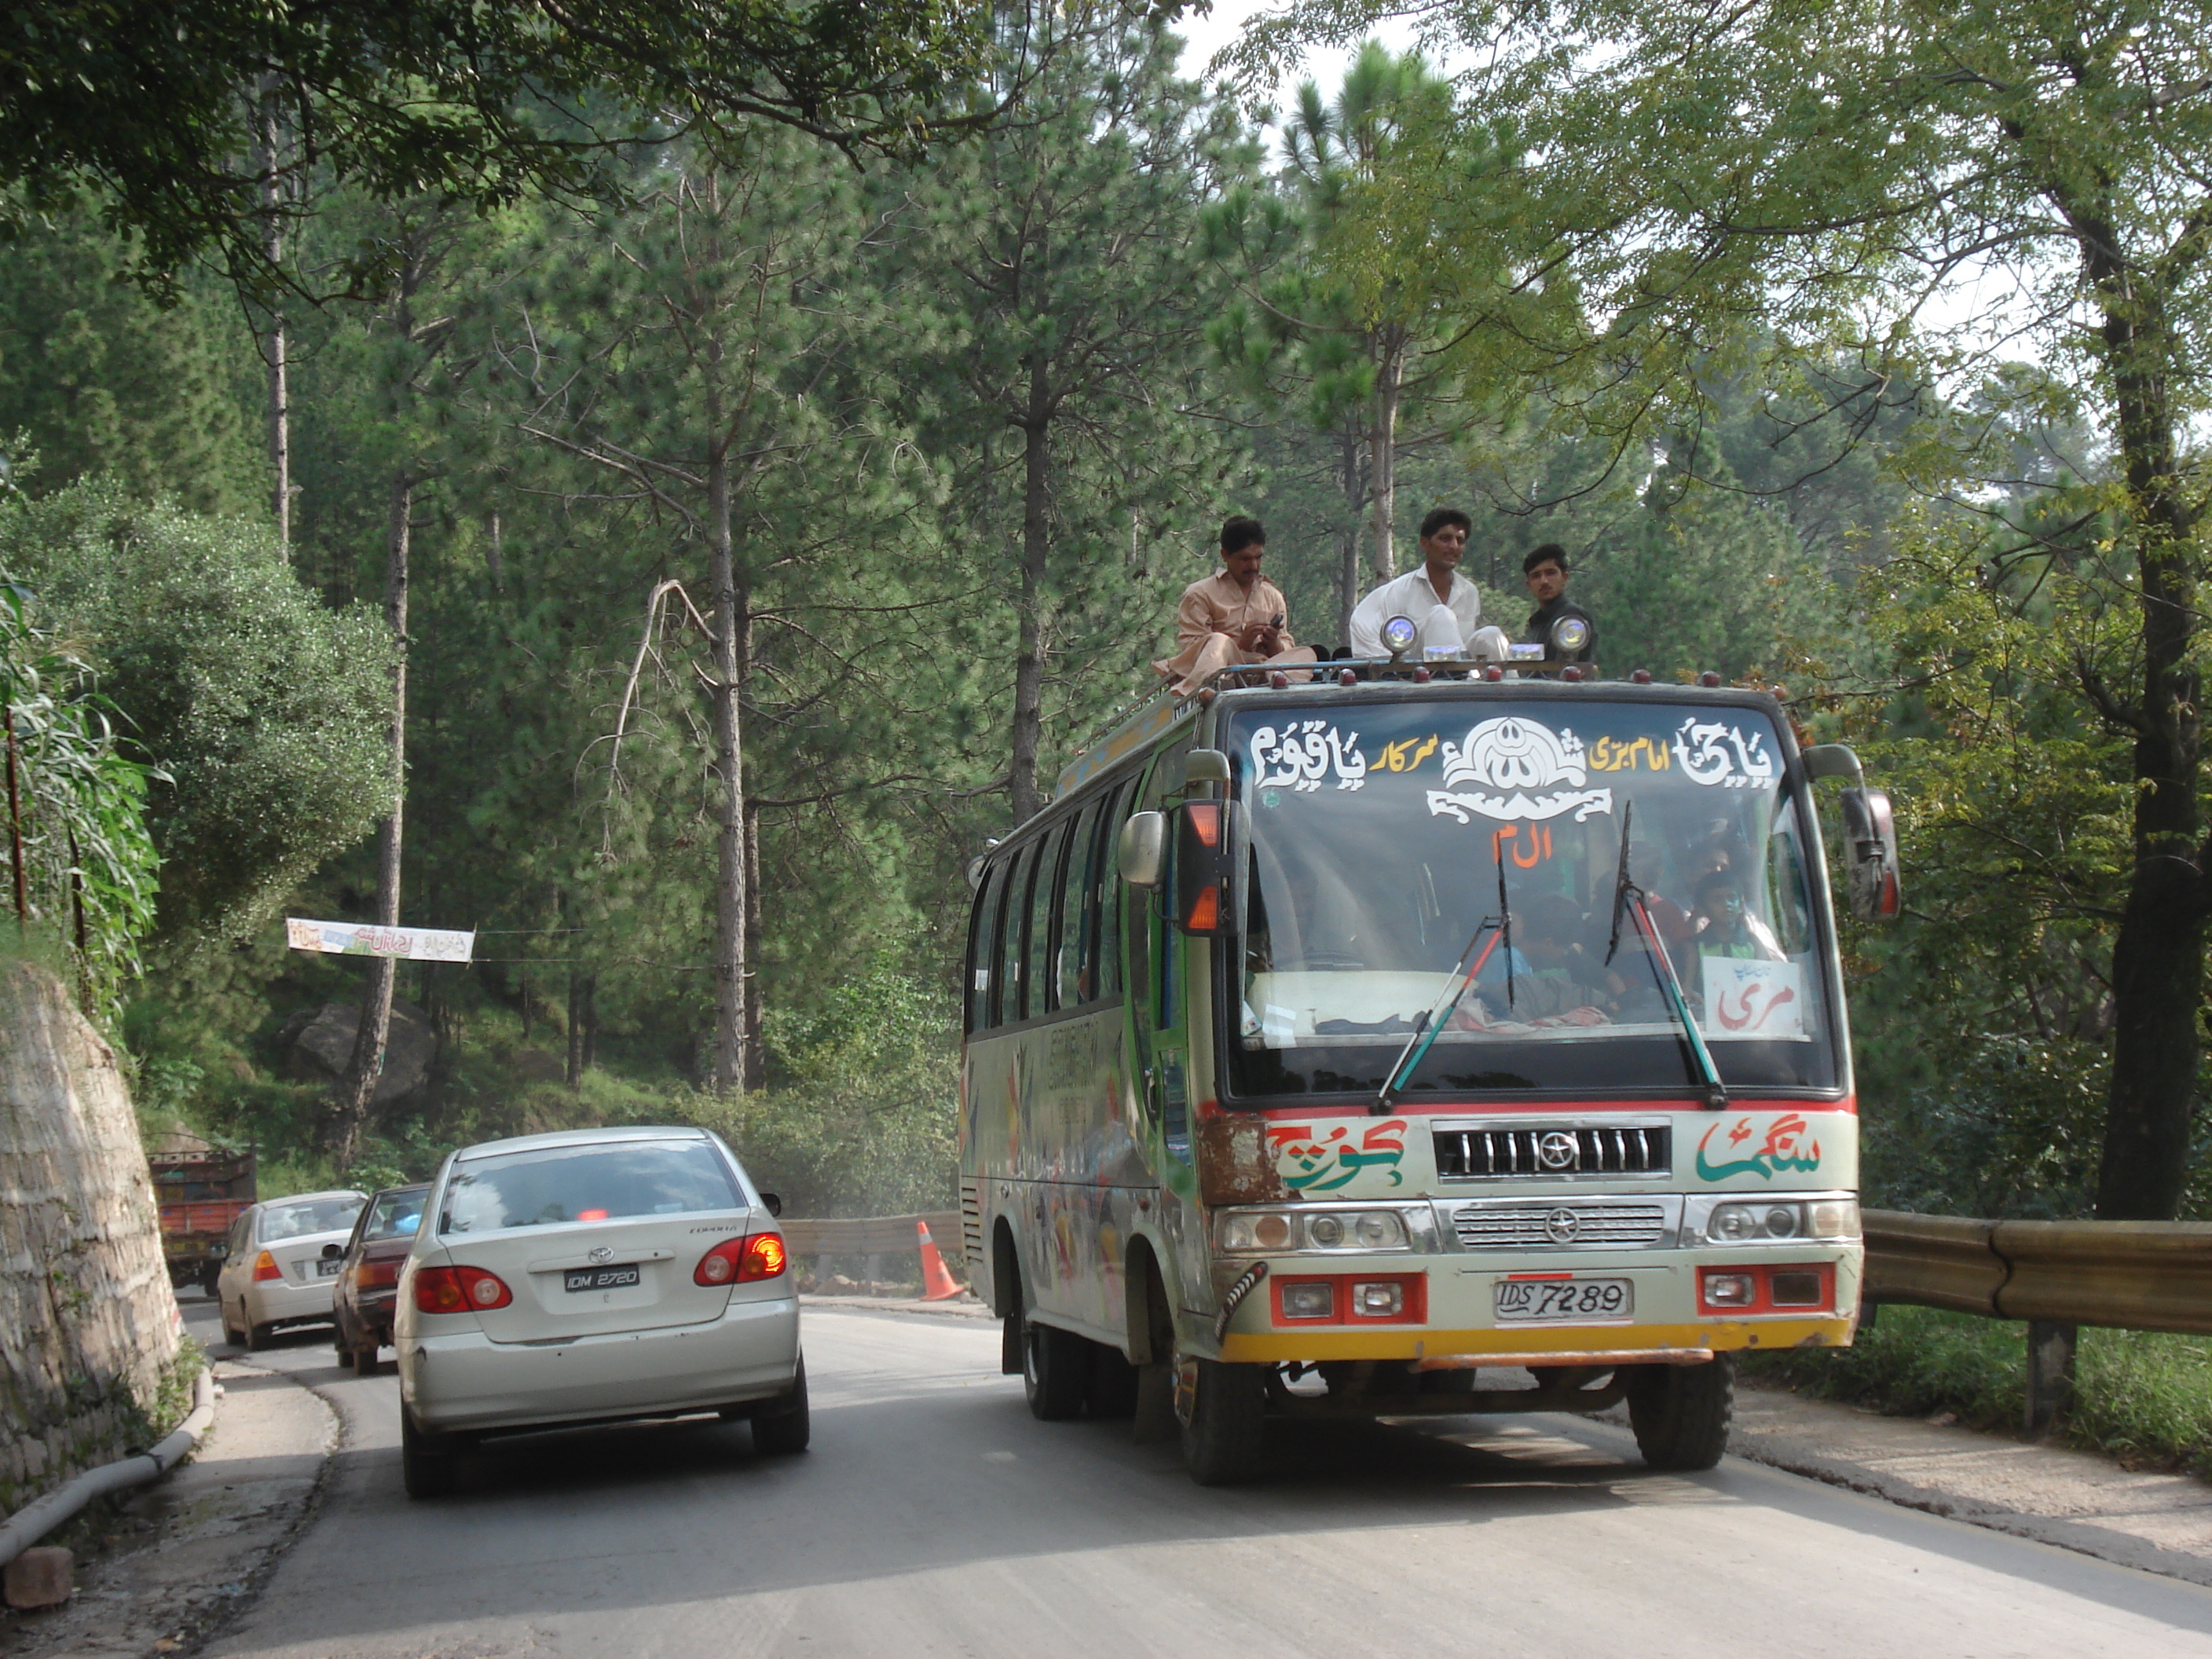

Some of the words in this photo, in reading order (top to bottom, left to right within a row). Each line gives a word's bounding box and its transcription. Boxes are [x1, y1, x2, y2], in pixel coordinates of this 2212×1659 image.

[1369, 734, 1438, 772] سرکار
[1718, 983, 1795, 1031] مری
[567, 1275, 591, 1289] IDM
[597, 1271, 637, 1286] 2720
[1497, 1284, 1536, 1307] IDS
[1534, 1284, 1624, 1315] 7289
